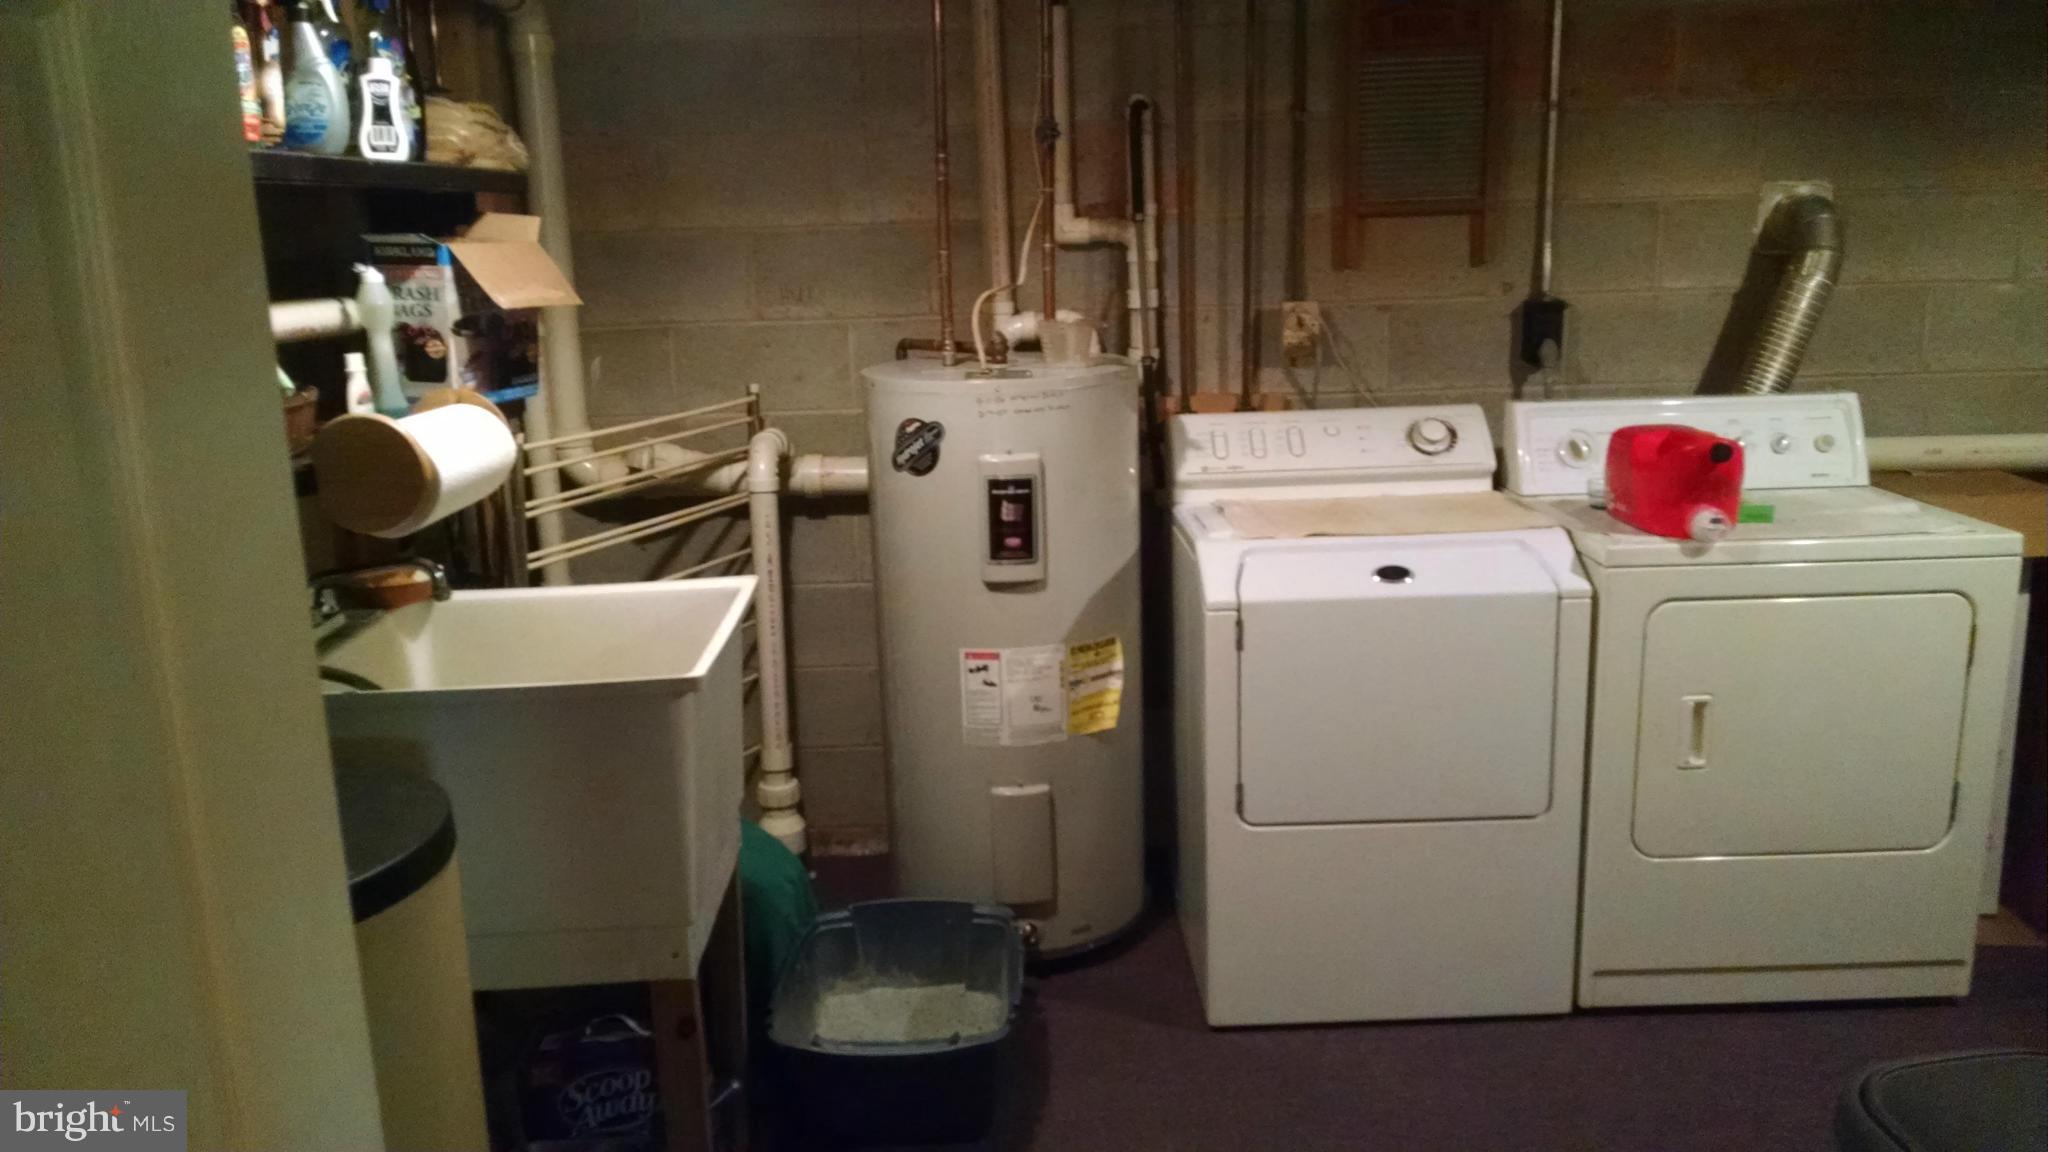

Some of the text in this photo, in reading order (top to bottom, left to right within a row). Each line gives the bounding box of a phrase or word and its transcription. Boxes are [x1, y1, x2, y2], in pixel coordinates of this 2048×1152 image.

[392, 286, 440, 301] RASH
[396, 304, 433, 318] AGS
[565, 1069, 652, 1110] Scoop
[577, 1091, 656, 1128] Away
